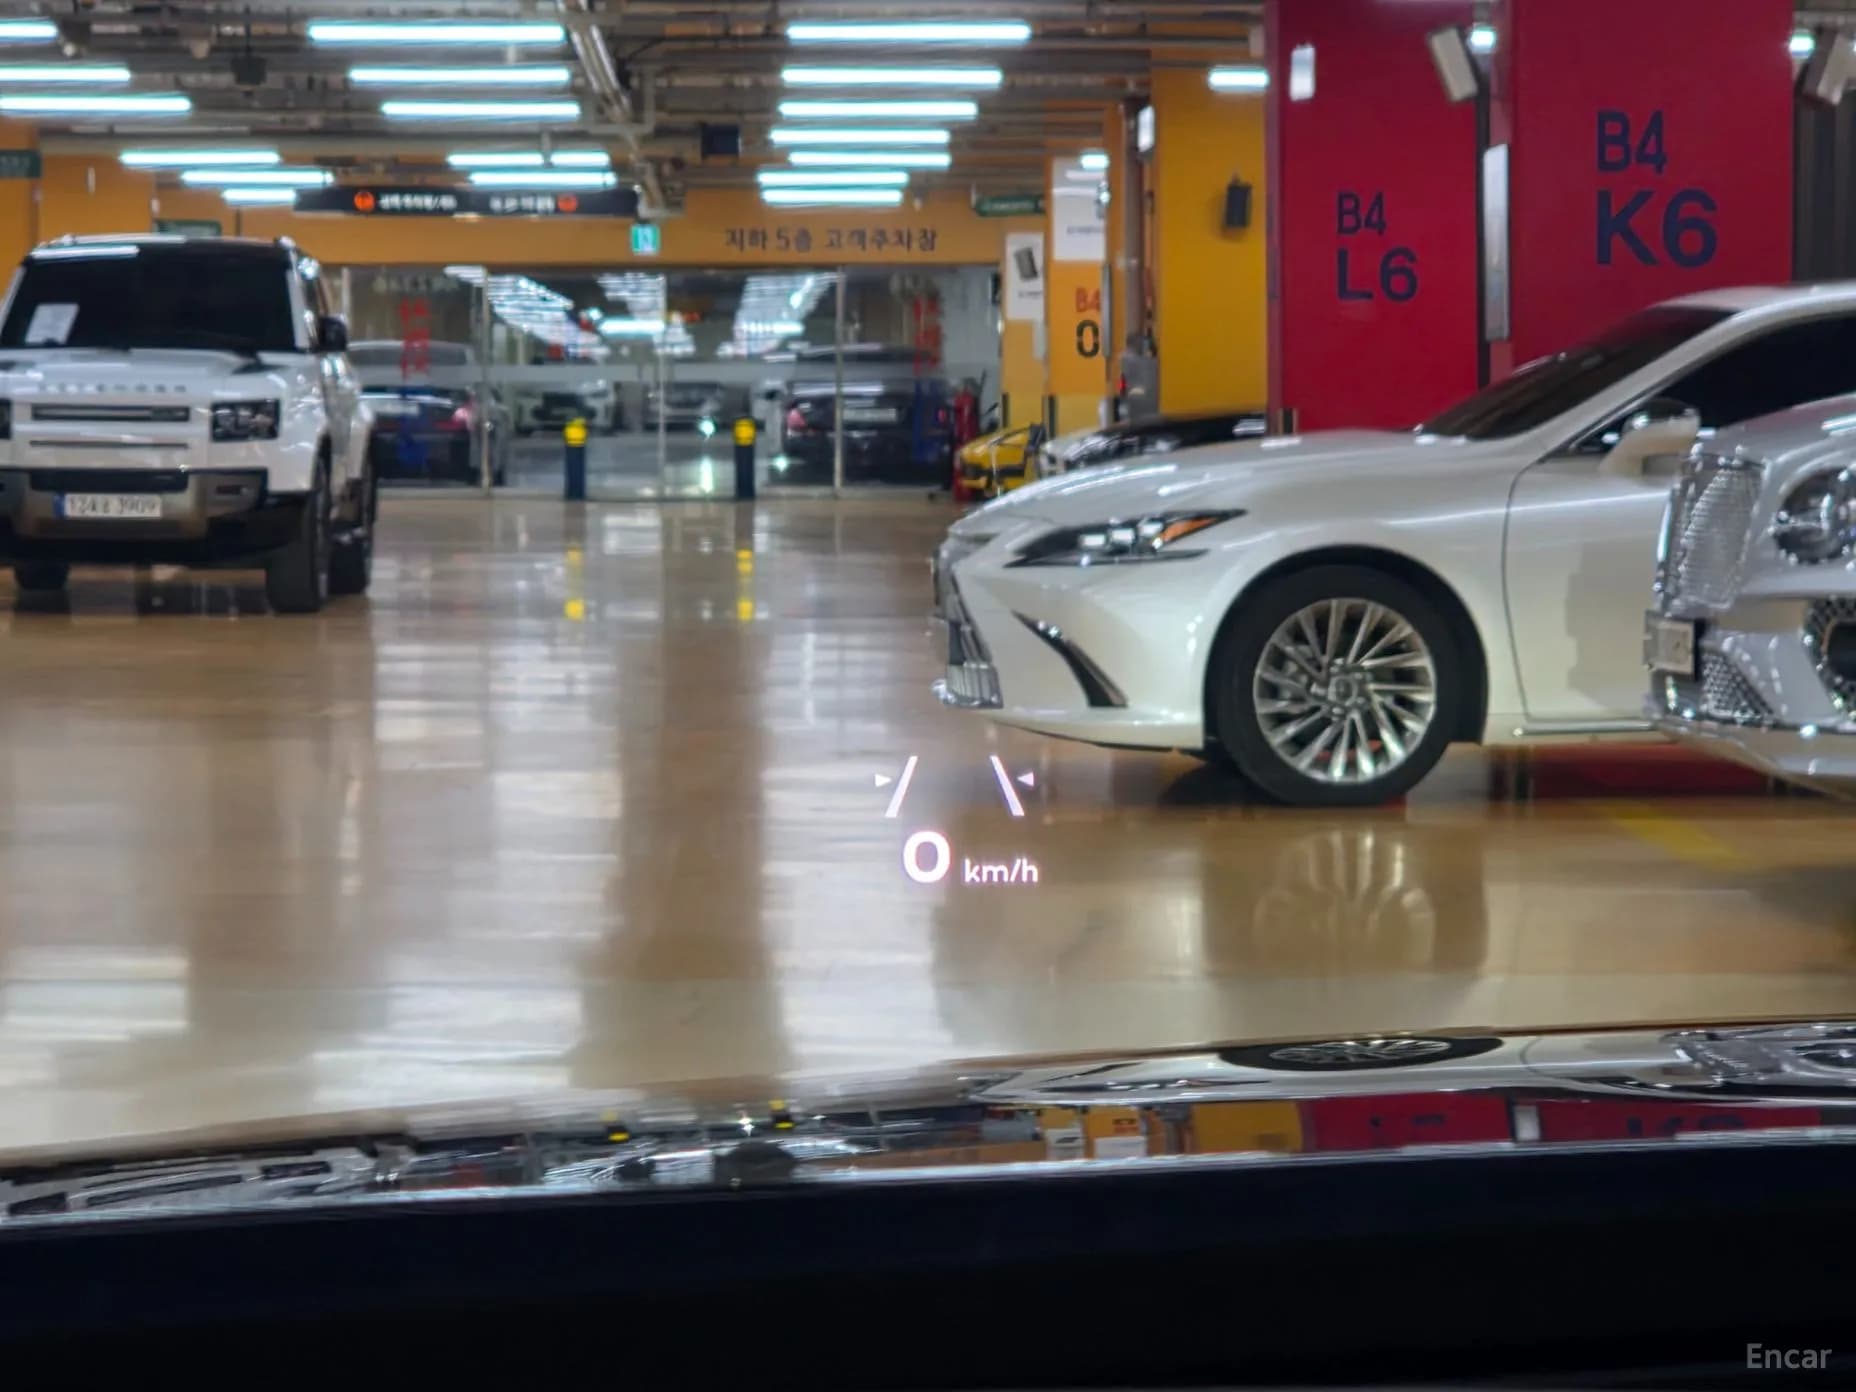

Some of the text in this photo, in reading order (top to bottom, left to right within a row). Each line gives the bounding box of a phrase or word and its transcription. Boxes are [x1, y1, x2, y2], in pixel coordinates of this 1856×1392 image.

[1597, 110, 1667, 174] B4
[1337, 191, 1386, 236] B4
[1597, 189, 1718, 268] K6
[1076, 287, 1101, 313] B4
[1337, 246, 1418, 302] L6
[903, 831, 1038, 883] 0 km/h
